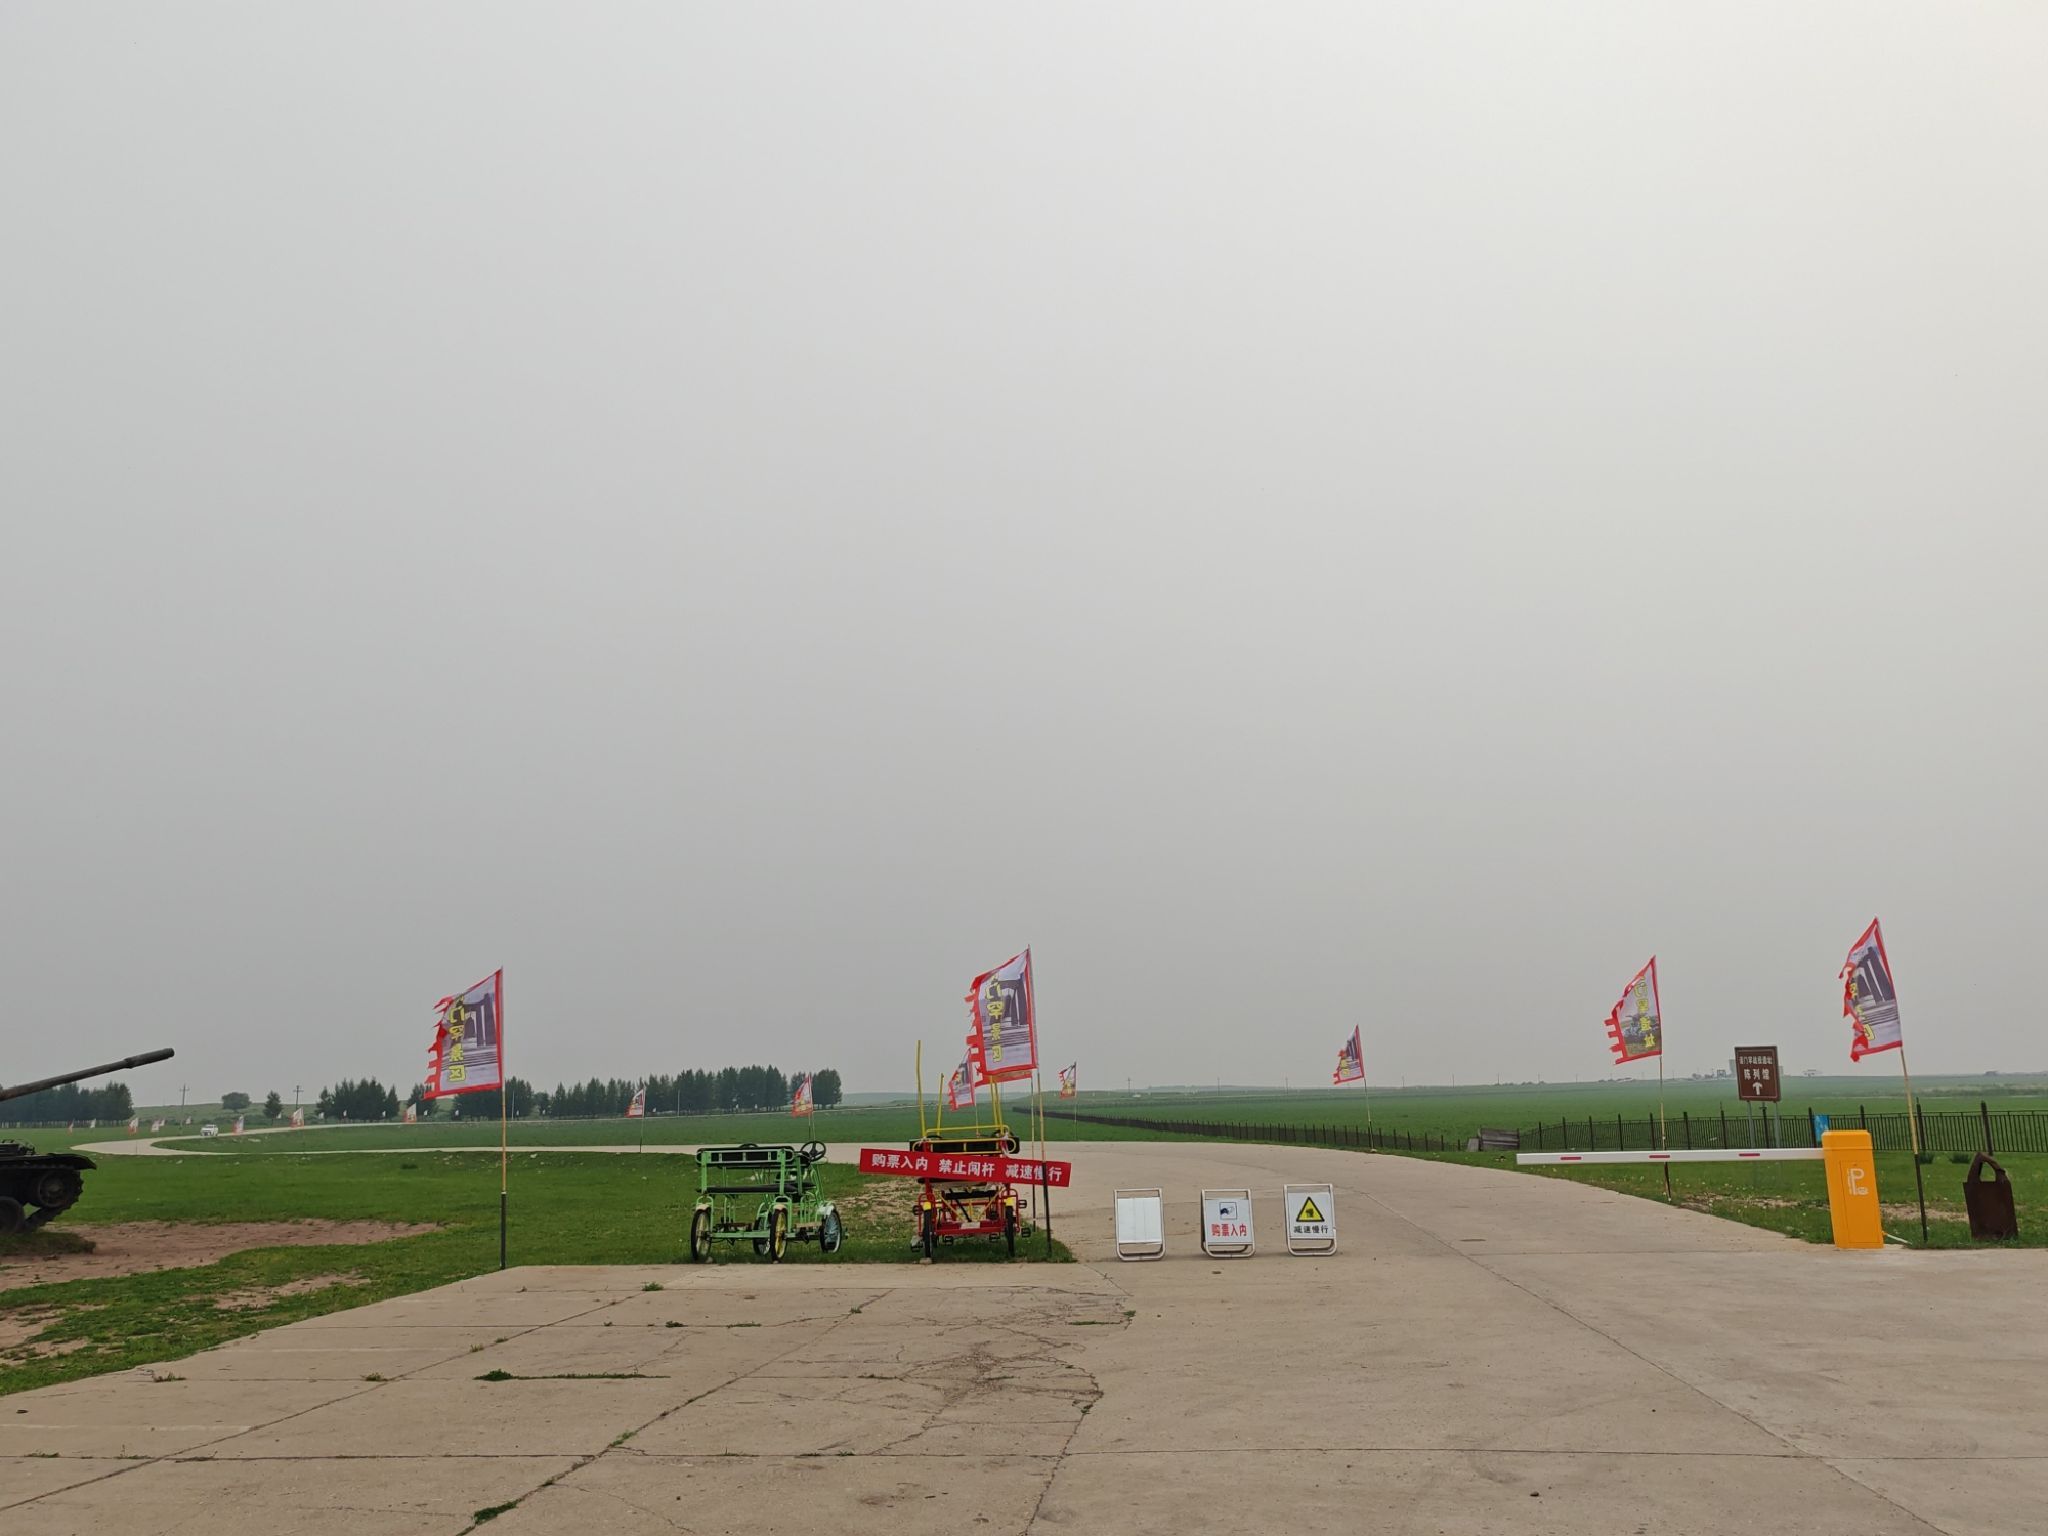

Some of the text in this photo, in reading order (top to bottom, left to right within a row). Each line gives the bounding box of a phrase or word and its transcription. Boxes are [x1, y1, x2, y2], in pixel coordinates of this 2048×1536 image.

[1744, 1068, 1770, 1081] 陈列馆
[871, 1153, 1062, 1182] 购票入内 禁止闯杆 减速慢行
[1211, 1223, 1247, 1237] 购票入内
[1293, 1225, 1329, 1234] 减速慢行
